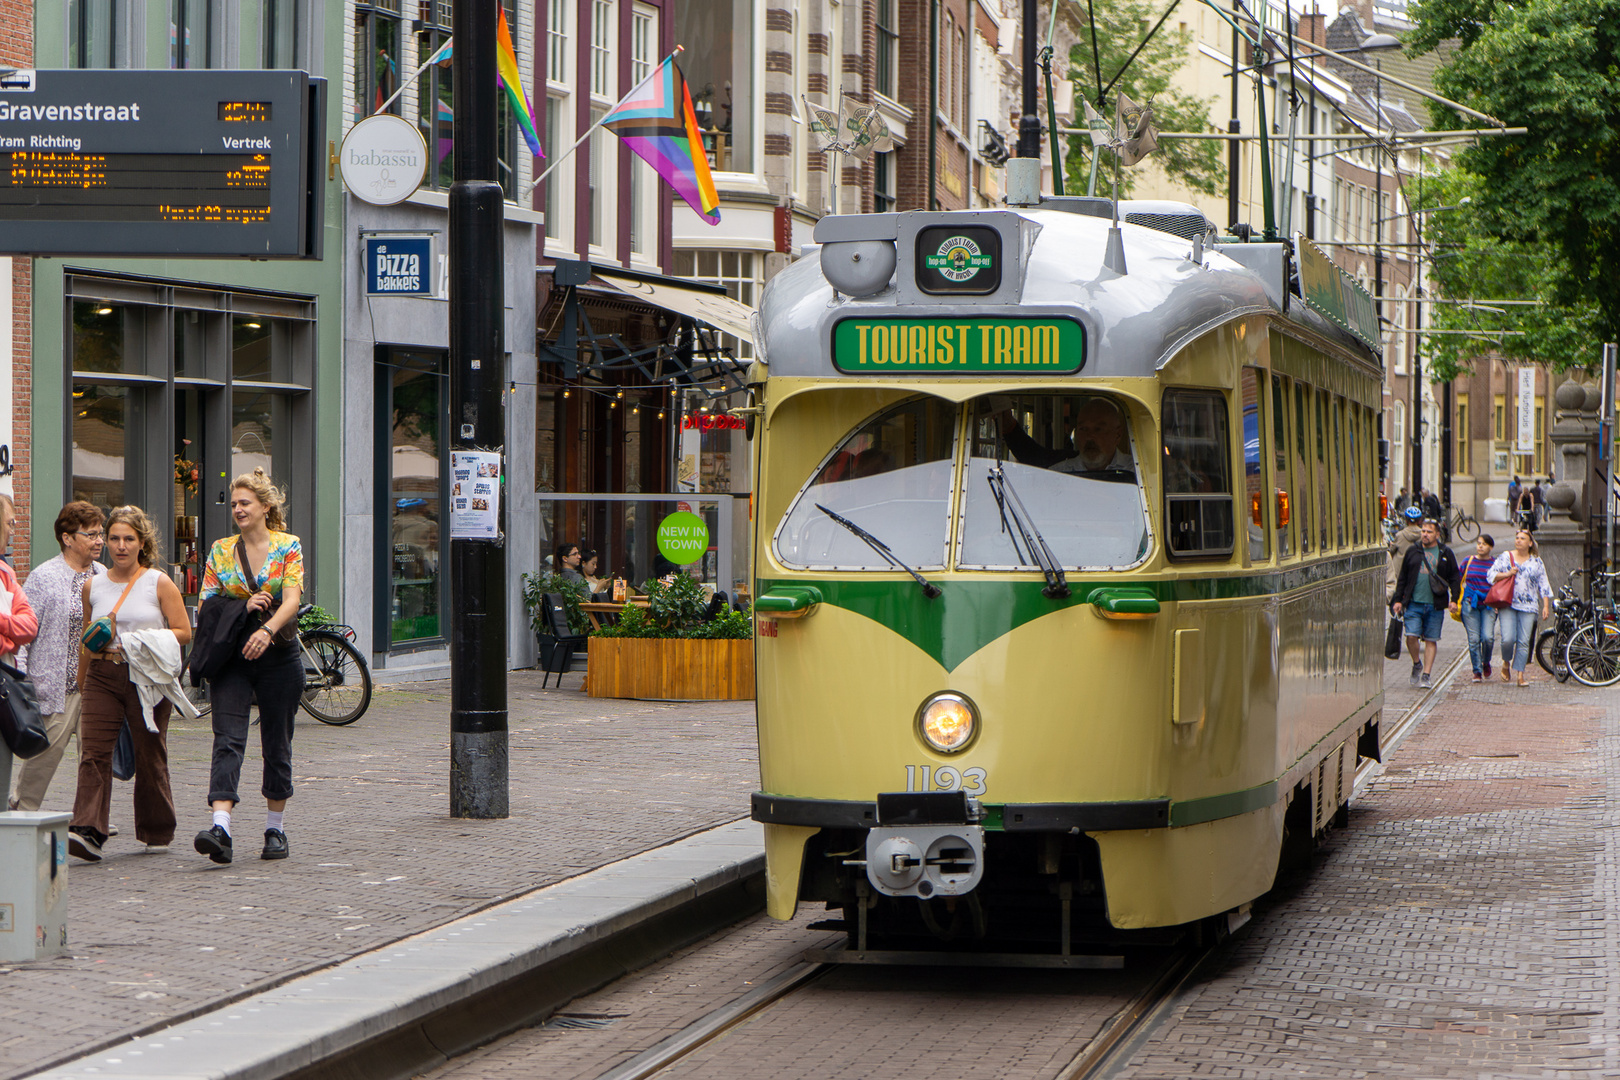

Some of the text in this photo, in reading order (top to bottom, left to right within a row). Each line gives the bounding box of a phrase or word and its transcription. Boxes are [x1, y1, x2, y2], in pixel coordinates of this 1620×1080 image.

[0, 135, 81, 151] ram Richting
[222, 136, 271, 149] Vertrek
[350, 149, 417, 167] babassu
[377, 245, 387, 254] de
[939, 237, 979, 255] TOURIST TRAM
[944, 269, 973, 280] THE HAGUE
[377, 276, 420, 291] bakkers
[855, 325, 1060, 364] TOURIST TRAM
[661, 526, 706, 537] NEW IN
[663, 539, 702, 550] TOWN
[905, 765, 987, 797] 1193
